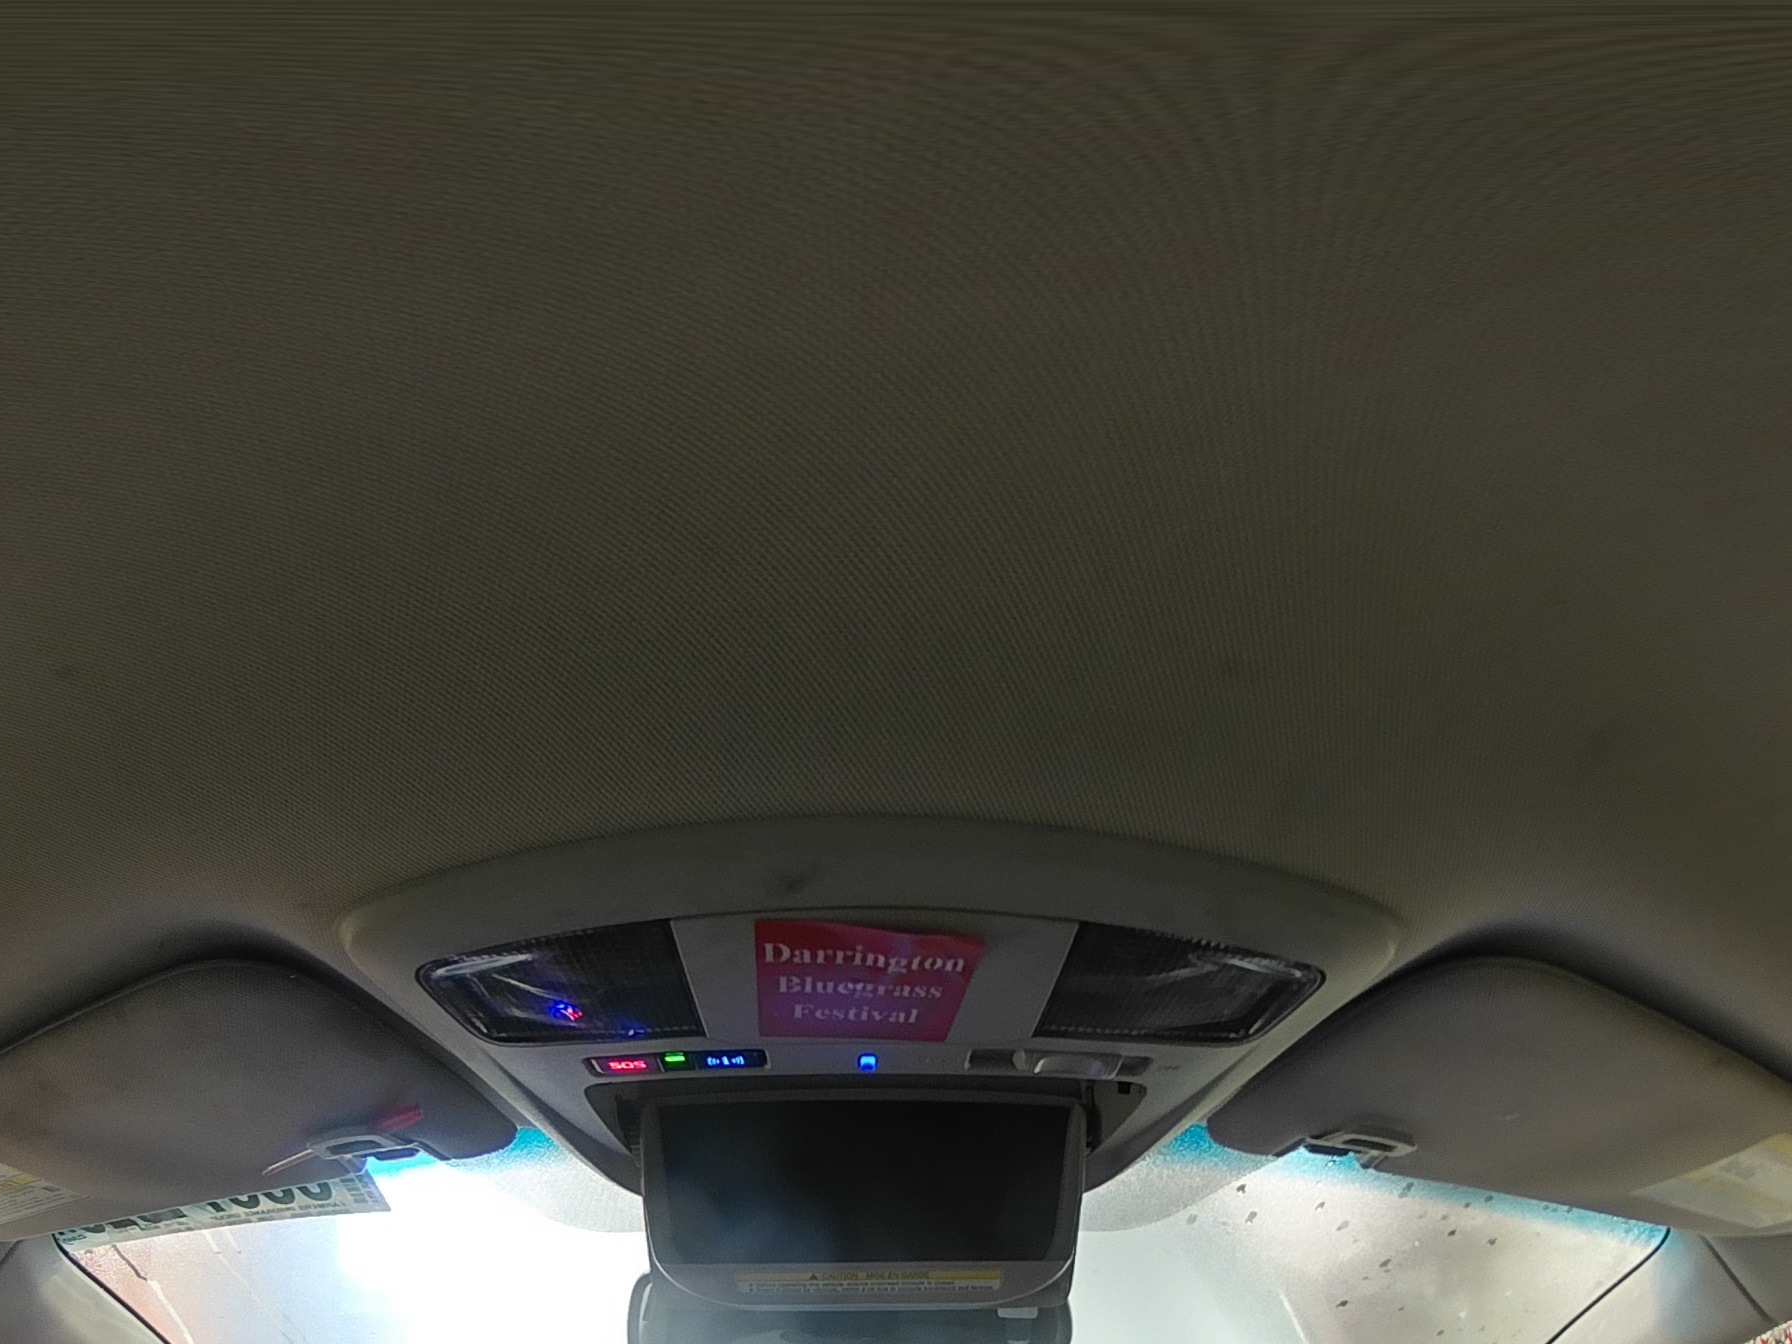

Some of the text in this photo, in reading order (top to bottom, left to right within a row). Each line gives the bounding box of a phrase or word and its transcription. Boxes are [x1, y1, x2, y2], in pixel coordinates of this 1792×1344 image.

[764, 942, 965, 974] Darrington
[778, 975, 943, 1000] Bluegrass
[793, 1003, 919, 1024] Festival
[608, 1060, 647, 1070] SOS
